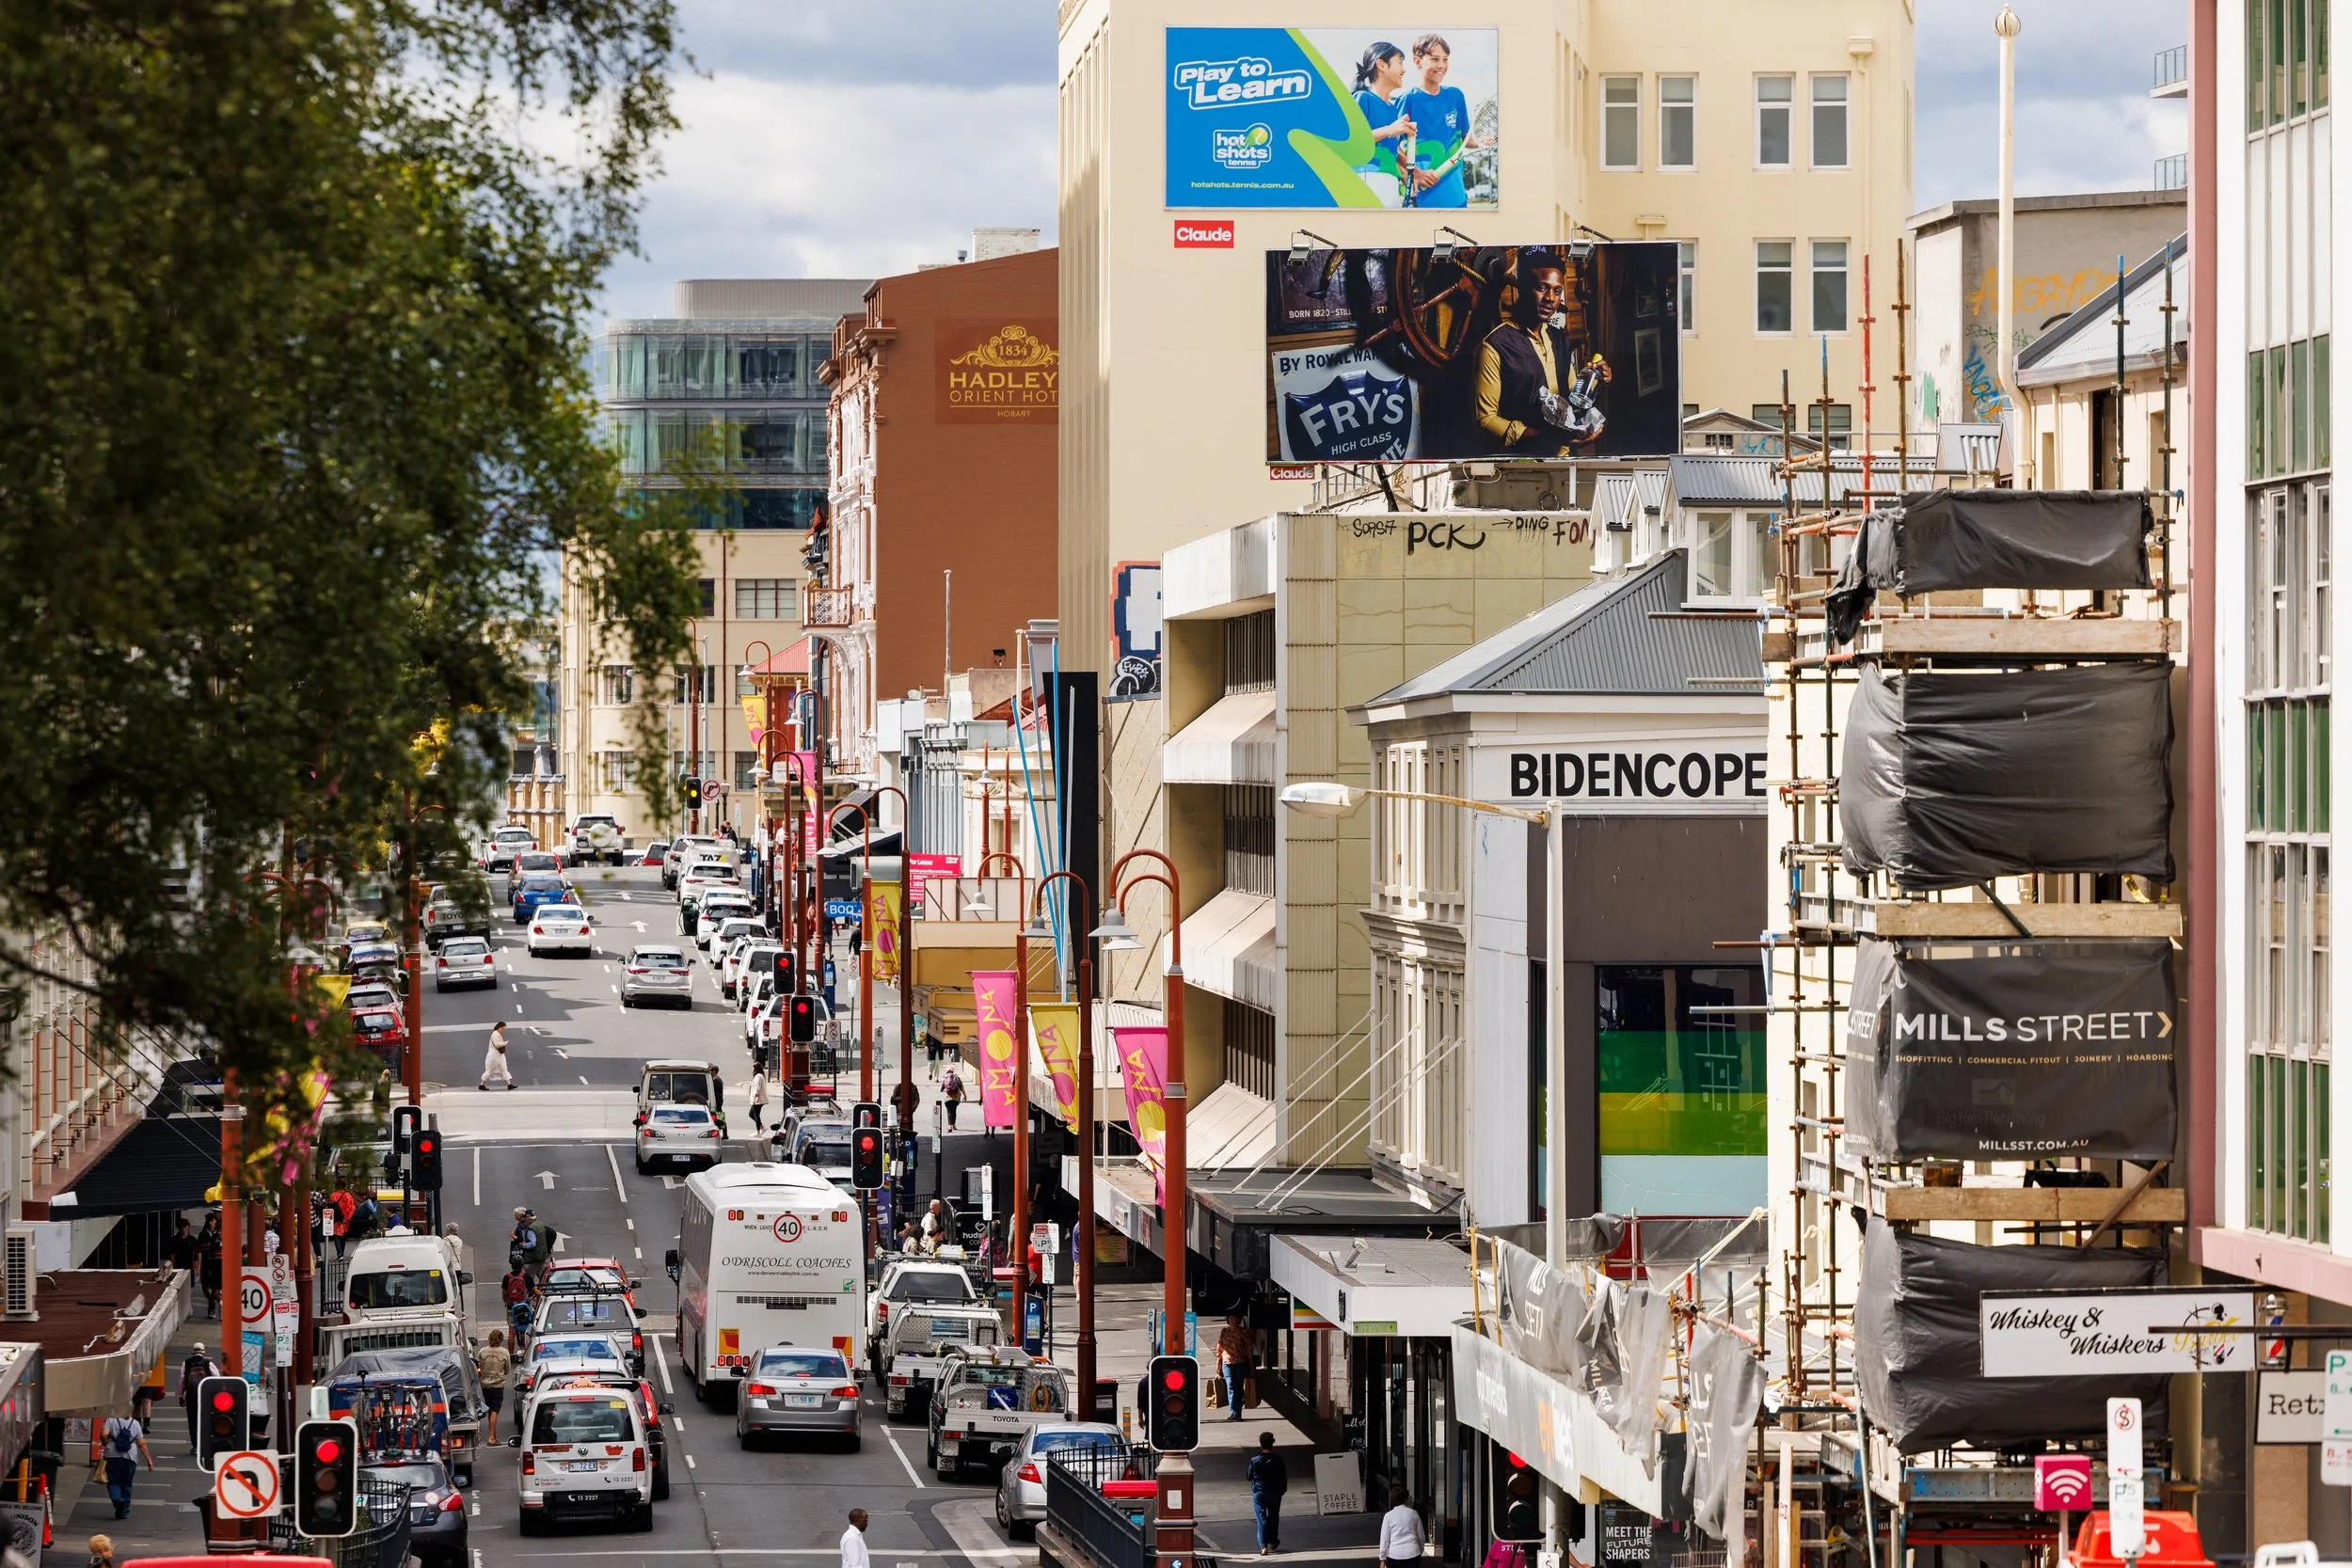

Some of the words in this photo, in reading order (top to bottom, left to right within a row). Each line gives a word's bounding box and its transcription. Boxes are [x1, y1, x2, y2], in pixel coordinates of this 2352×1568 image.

[1180, 66, 1235, 84] Play
[1240, 62, 1266, 77] to
[1195, 75, 1306, 103] Learn
[1216, 133, 1246, 147] hot
[1216, 146, 1268, 159] shots
[1190, 181, 1295, 189] hotshots.tennis.com.au
[1176, 226, 1232, 244] Claude
[1289, 309, 1311, 319] BORN
[998, 345, 1028, 356] 1834
[1279, 356, 1301, 372] BY
[949, 372, 1057, 388] HADLEY
[949, 390, 1014, 403] ORIENT
[1298, 388, 1406, 447] FRY'S
[1331, 440, 1357, 455] HIGH
[1360, 431, 1392, 449] CLASS
[1270, 467, 1316, 480] Claude
[829, 904, 854, 914] BOQ
[1895, 1012, 2008, 1042] MILLS
[2016, 1011, 2153, 1042] STREET
[1895, 1054, 1953, 1064] SHOPFITTING
[1967, 1056, 2027, 1065] COMMERCIAL
[2030, 1056, 2061, 1065] FITOUT
[2074, 1054, 2113, 1063] JOINERY
[1979, 1139, 2090, 1151] MILLSST.COM.AU
[778, 1221, 798, 1236] 40
[722, 1257, 793, 1267] O'DRISCOLL
[796, 1258, 851, 1269] COACHES
[241, 1289, 263, 1310] 40
[1029, 1303, 1037, 1313] P
[1989, 1306, 2077, 1338] Whiskey
[2082, 1307, 2105, 1328] &
[2070, 1332, 2167, 1355] Whiskers
[2329, 1354, 2346, 1375] P
[1324, 1492, 1358, 1503] STAPLE
[1324, 1500, 1359, 1511] COFFEE
[1605, 1527, 1630, 1538] MEET
[1634, 1527, 1652, 1538] THE
[1606, 1536, 1652, 1549] FUTURE
[1605, 1548, 1650, 1560] SHAPERS
